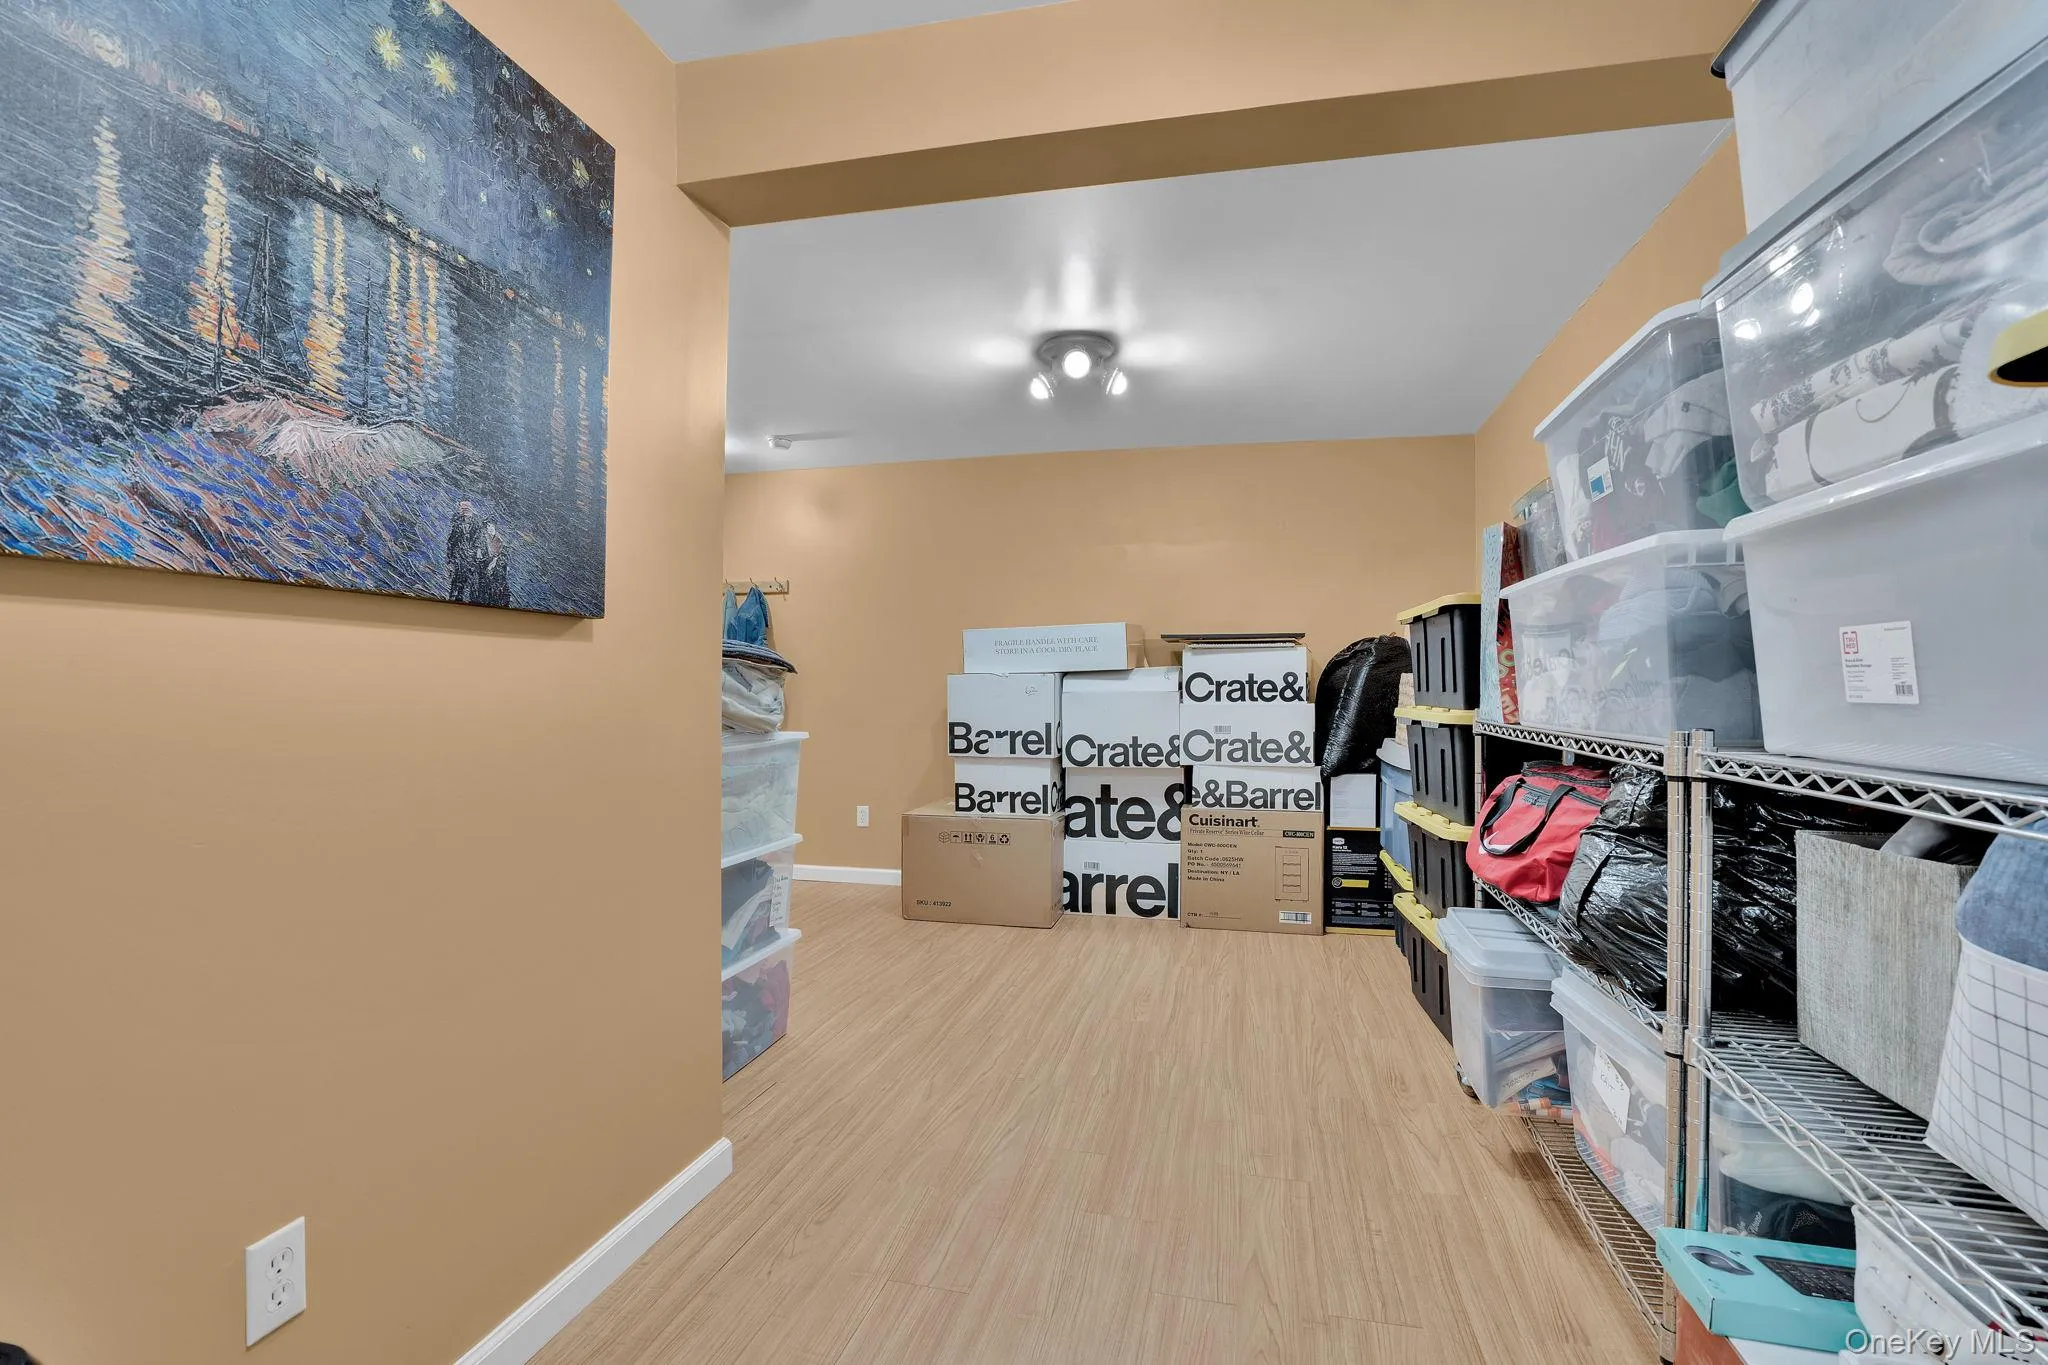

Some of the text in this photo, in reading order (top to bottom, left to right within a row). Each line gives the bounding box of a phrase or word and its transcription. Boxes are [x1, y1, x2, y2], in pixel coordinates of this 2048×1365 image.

[1025, 638, 1055, 646] HANDLE
[1056, 637, 1077, 645] WITH
[1078, 636, 1098, 644] CARE
[1185, 671, 1305, 702] Crate&
[1183, 728, 1313, 764] Crate&
[955, 782, 1049, 814] Barrel
[1189, 813, 1258, 827] Cuisinart
